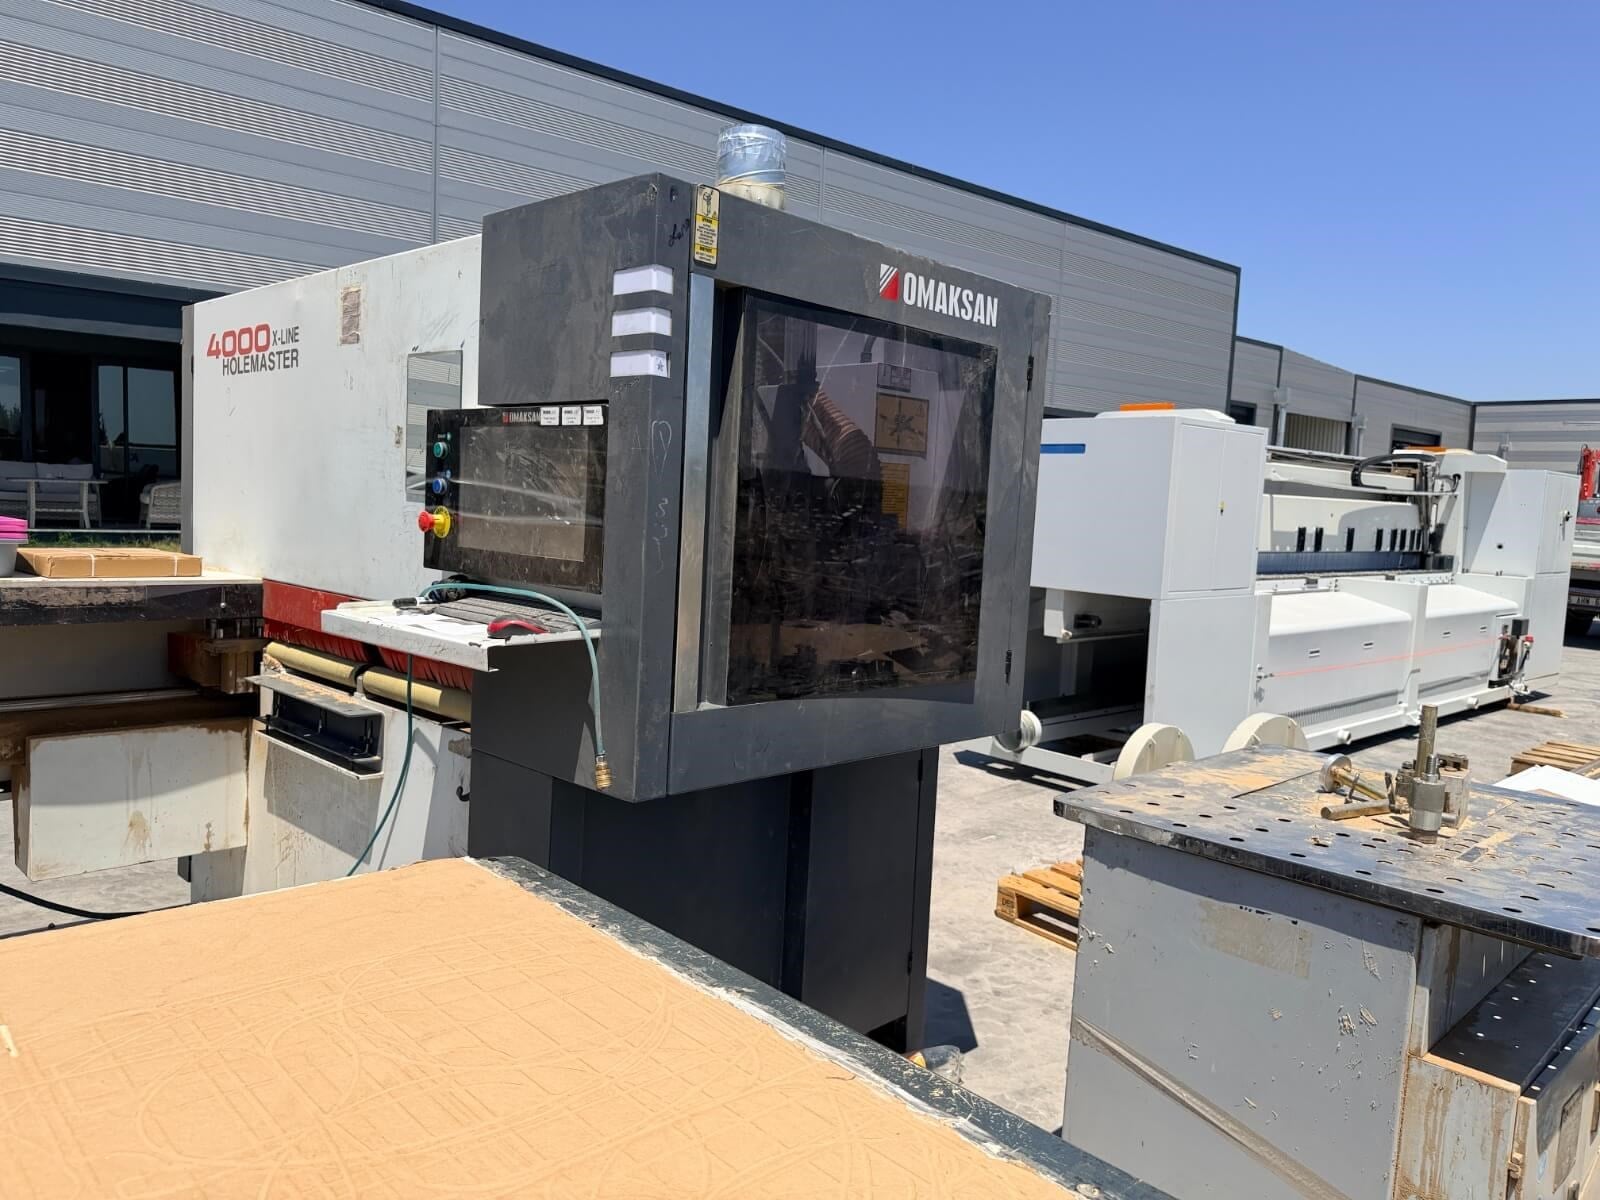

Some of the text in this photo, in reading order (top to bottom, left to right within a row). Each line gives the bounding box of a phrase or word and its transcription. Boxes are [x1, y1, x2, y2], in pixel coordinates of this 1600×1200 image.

[903, 272, 998, 328] OMAKSAN
[207, 323, 299, 359] 4000 X-LINE
[222, 348, 299, 376] HOLEMASTER
